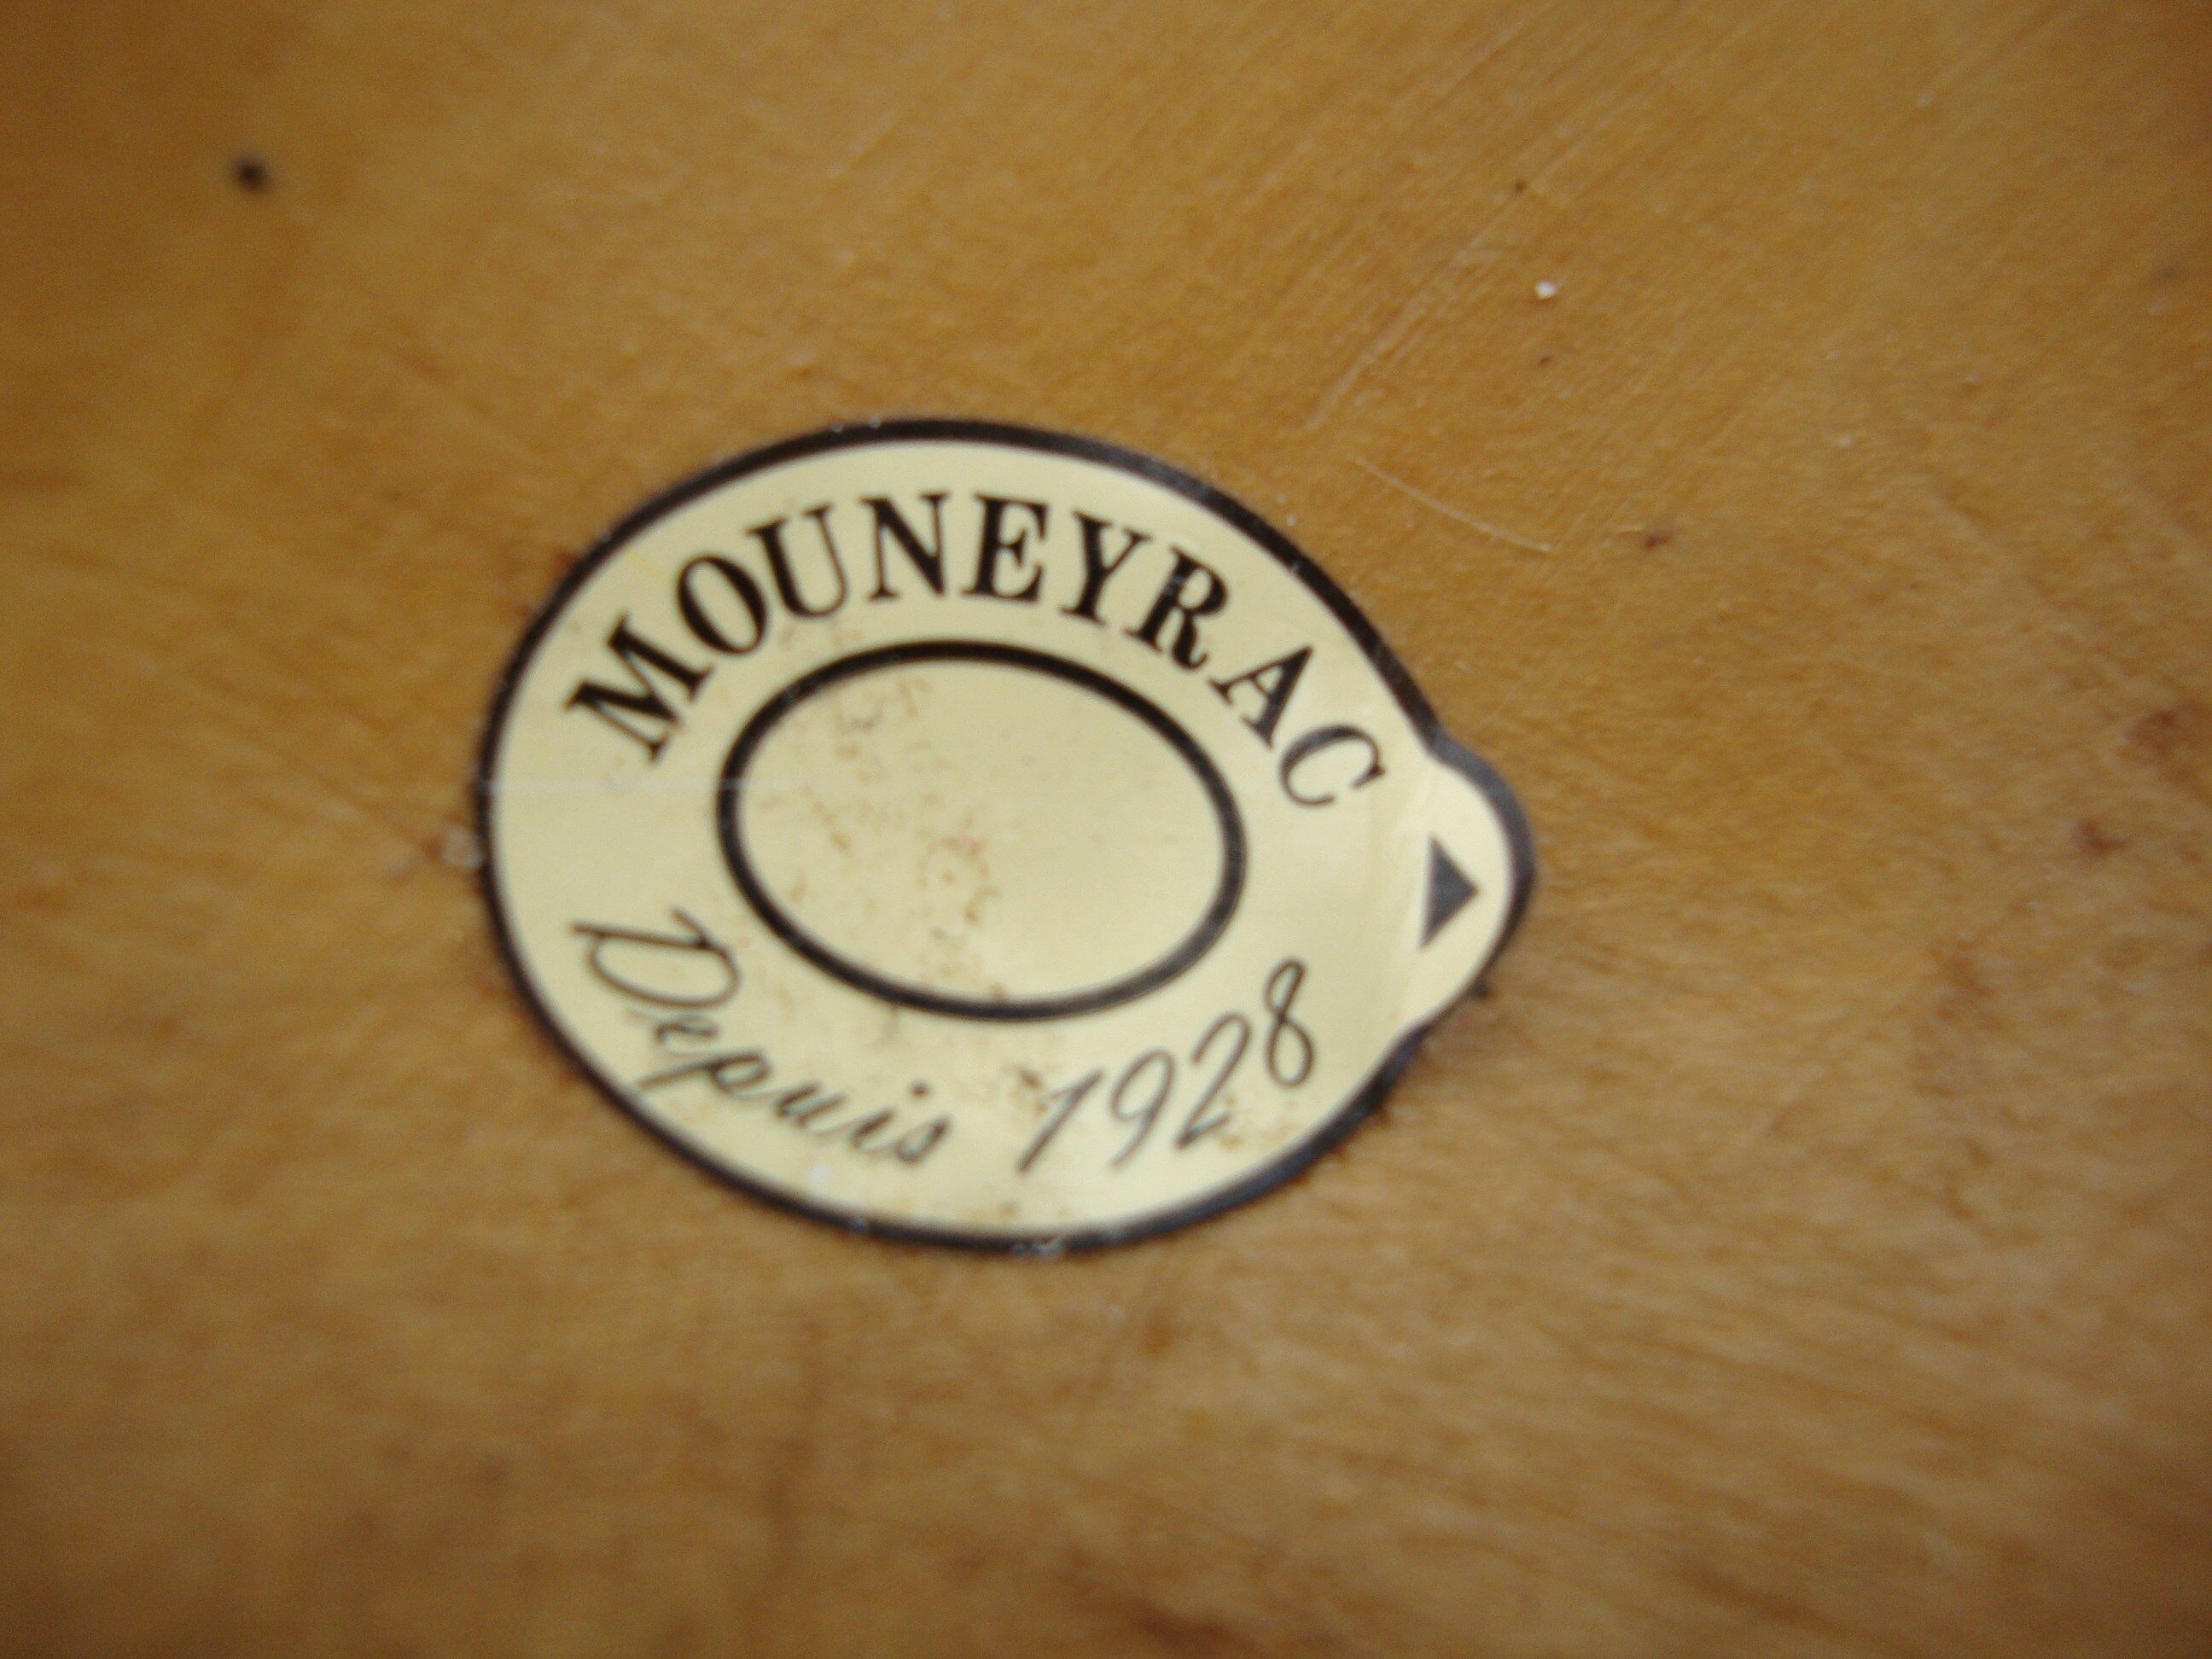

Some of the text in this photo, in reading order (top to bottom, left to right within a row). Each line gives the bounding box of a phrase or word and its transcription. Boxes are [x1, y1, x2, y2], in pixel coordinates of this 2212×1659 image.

[562, 490, 1387, 810] MOUNEYRAC
[570, 908, 1317, 1174] Depuis 1928
